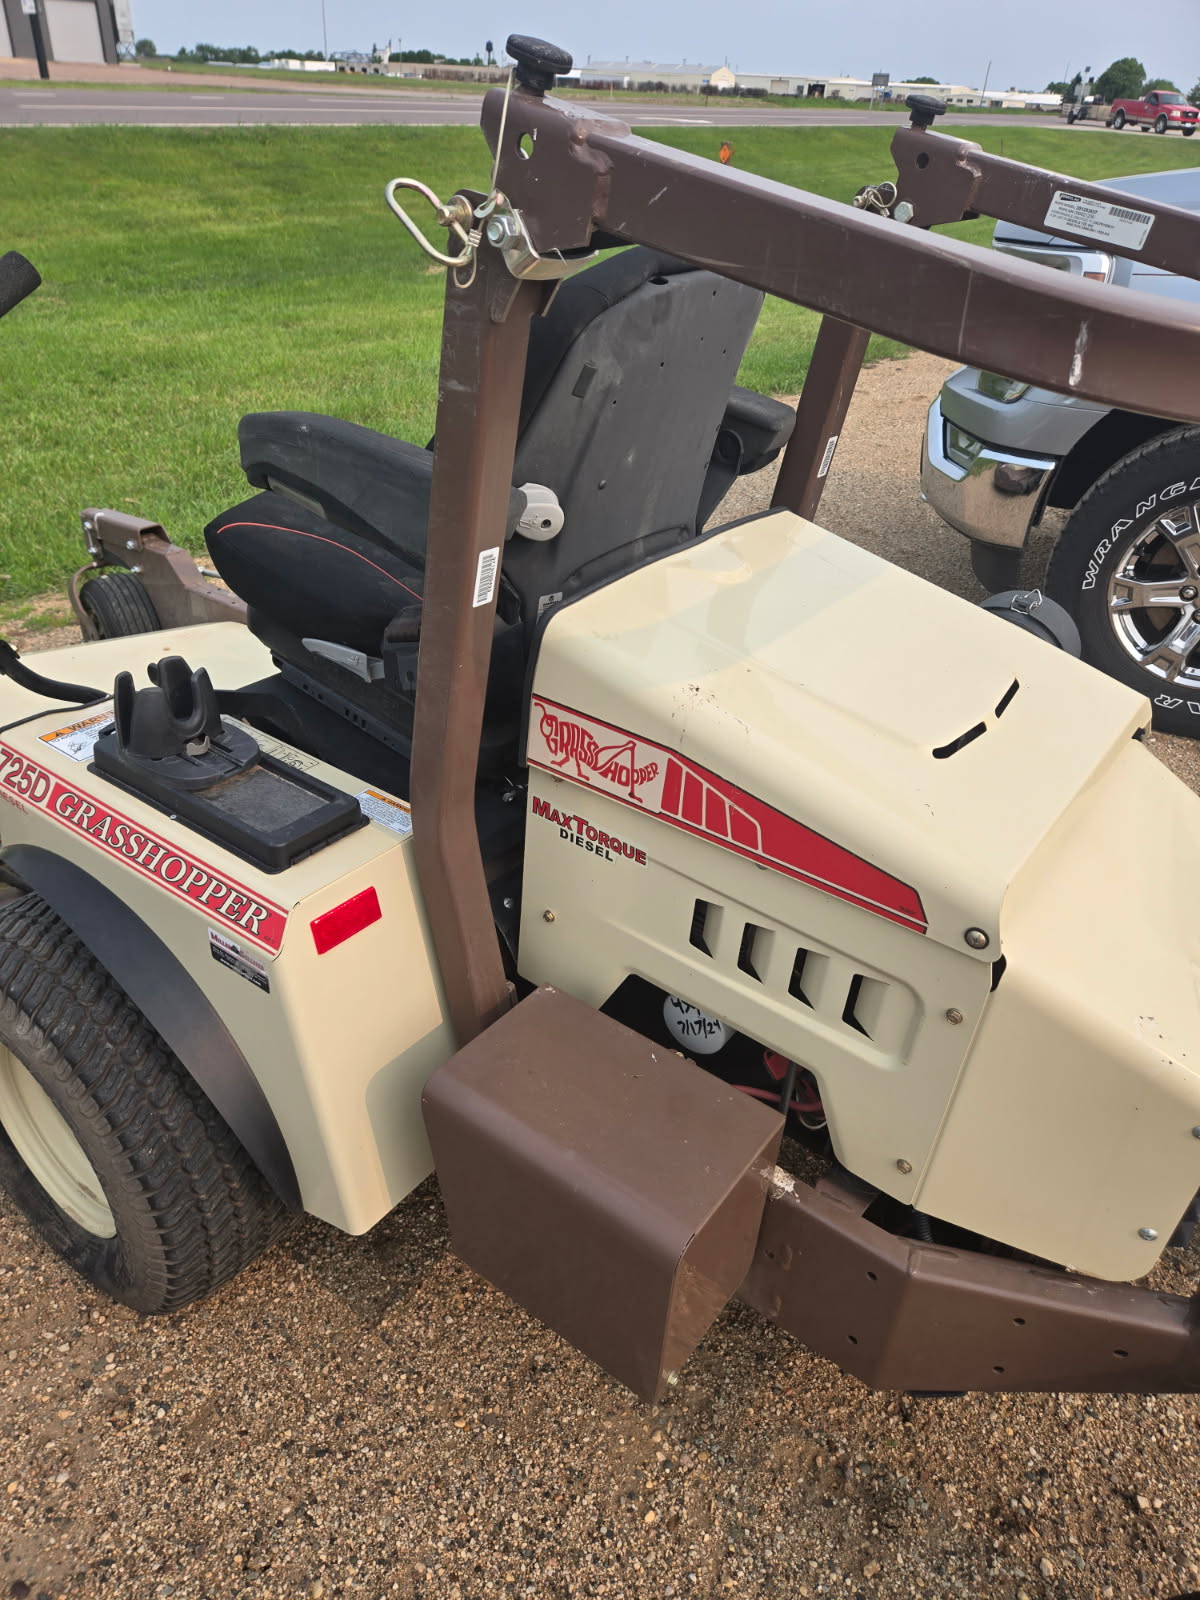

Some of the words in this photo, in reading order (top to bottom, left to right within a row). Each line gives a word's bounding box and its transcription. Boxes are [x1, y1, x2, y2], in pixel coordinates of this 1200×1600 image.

[67, 711, 114, 732] WARN
[0, 748, 51, 803] 725D
[559, 828, 614, 862] DIESEL
[55, 792, 268, 935] GRASSHOPPER
[677, 1017, 722, 1039] 7/17/24
